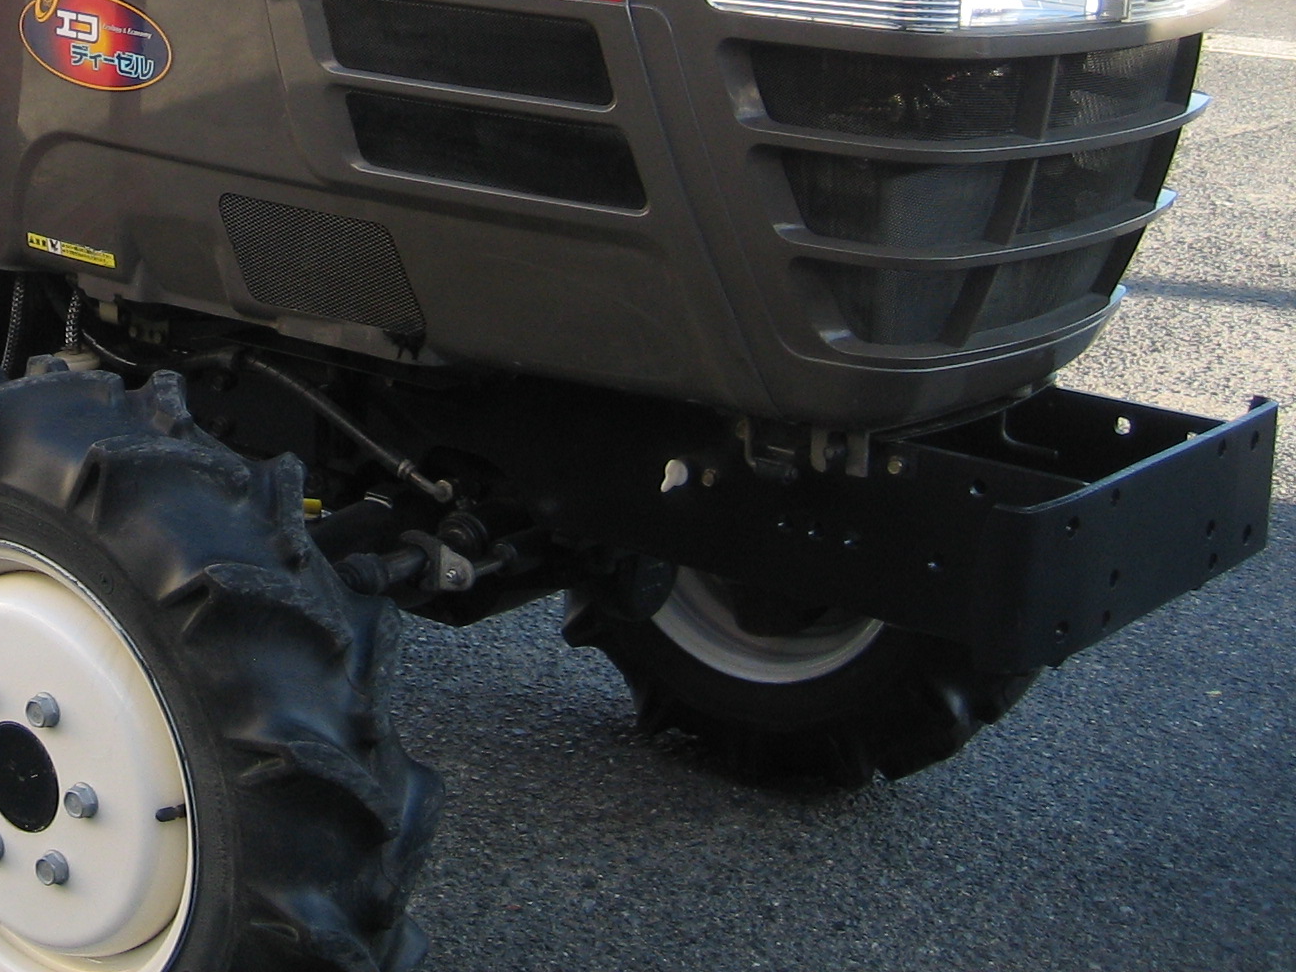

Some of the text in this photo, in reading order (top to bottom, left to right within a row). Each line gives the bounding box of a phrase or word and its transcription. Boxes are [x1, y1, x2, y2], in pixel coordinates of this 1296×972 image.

[55, 9, 100, 43] エコ
[70, 42, 155, 80] ディーゼル
